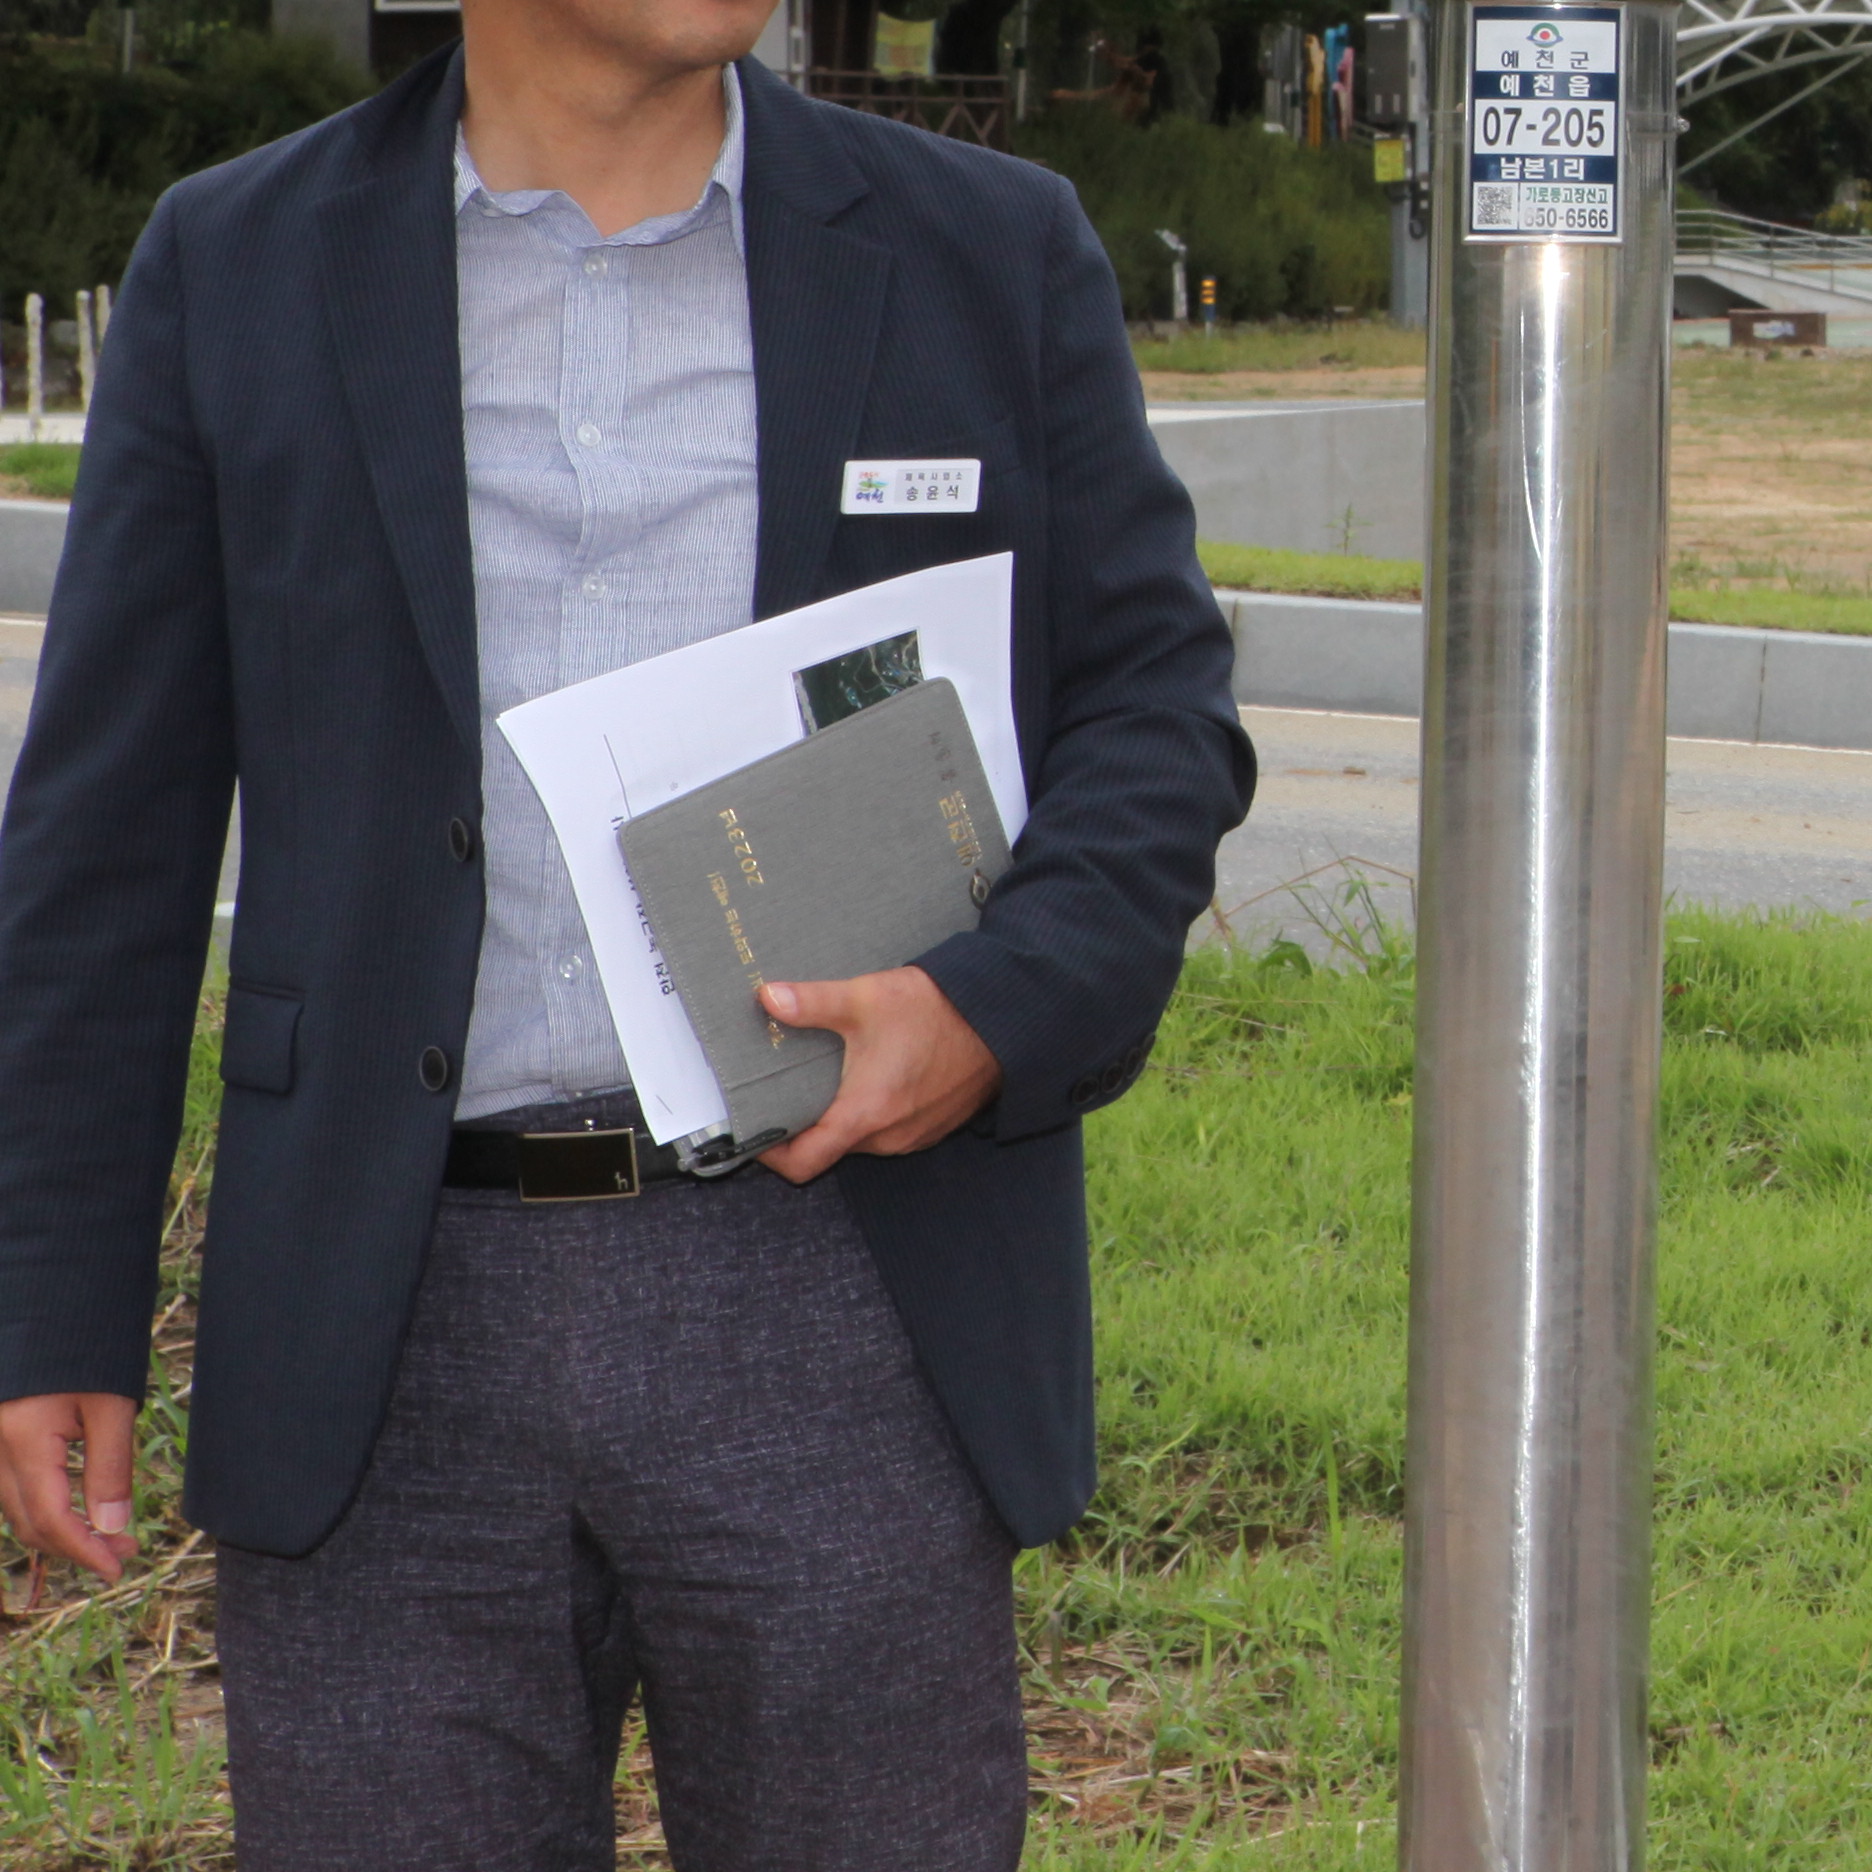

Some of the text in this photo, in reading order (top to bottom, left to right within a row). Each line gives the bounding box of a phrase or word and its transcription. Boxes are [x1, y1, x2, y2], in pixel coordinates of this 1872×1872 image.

[1501, 49, 1590, 70] 예천군
[1500, 74, 1590, 97] 예천읍
[1483, 106, 1605, 148] 07-205
[1500, 157, 1585, 180] 남본1리
[1526, 187, 1608, 204] 가로등고장신고
[1525, 207, 1608, 228] 650-6566
[906, 485, 959, 502] 송윤석
[938, 794, 975, 867] 예천군
[719, 808, 765, 888] 2023년
